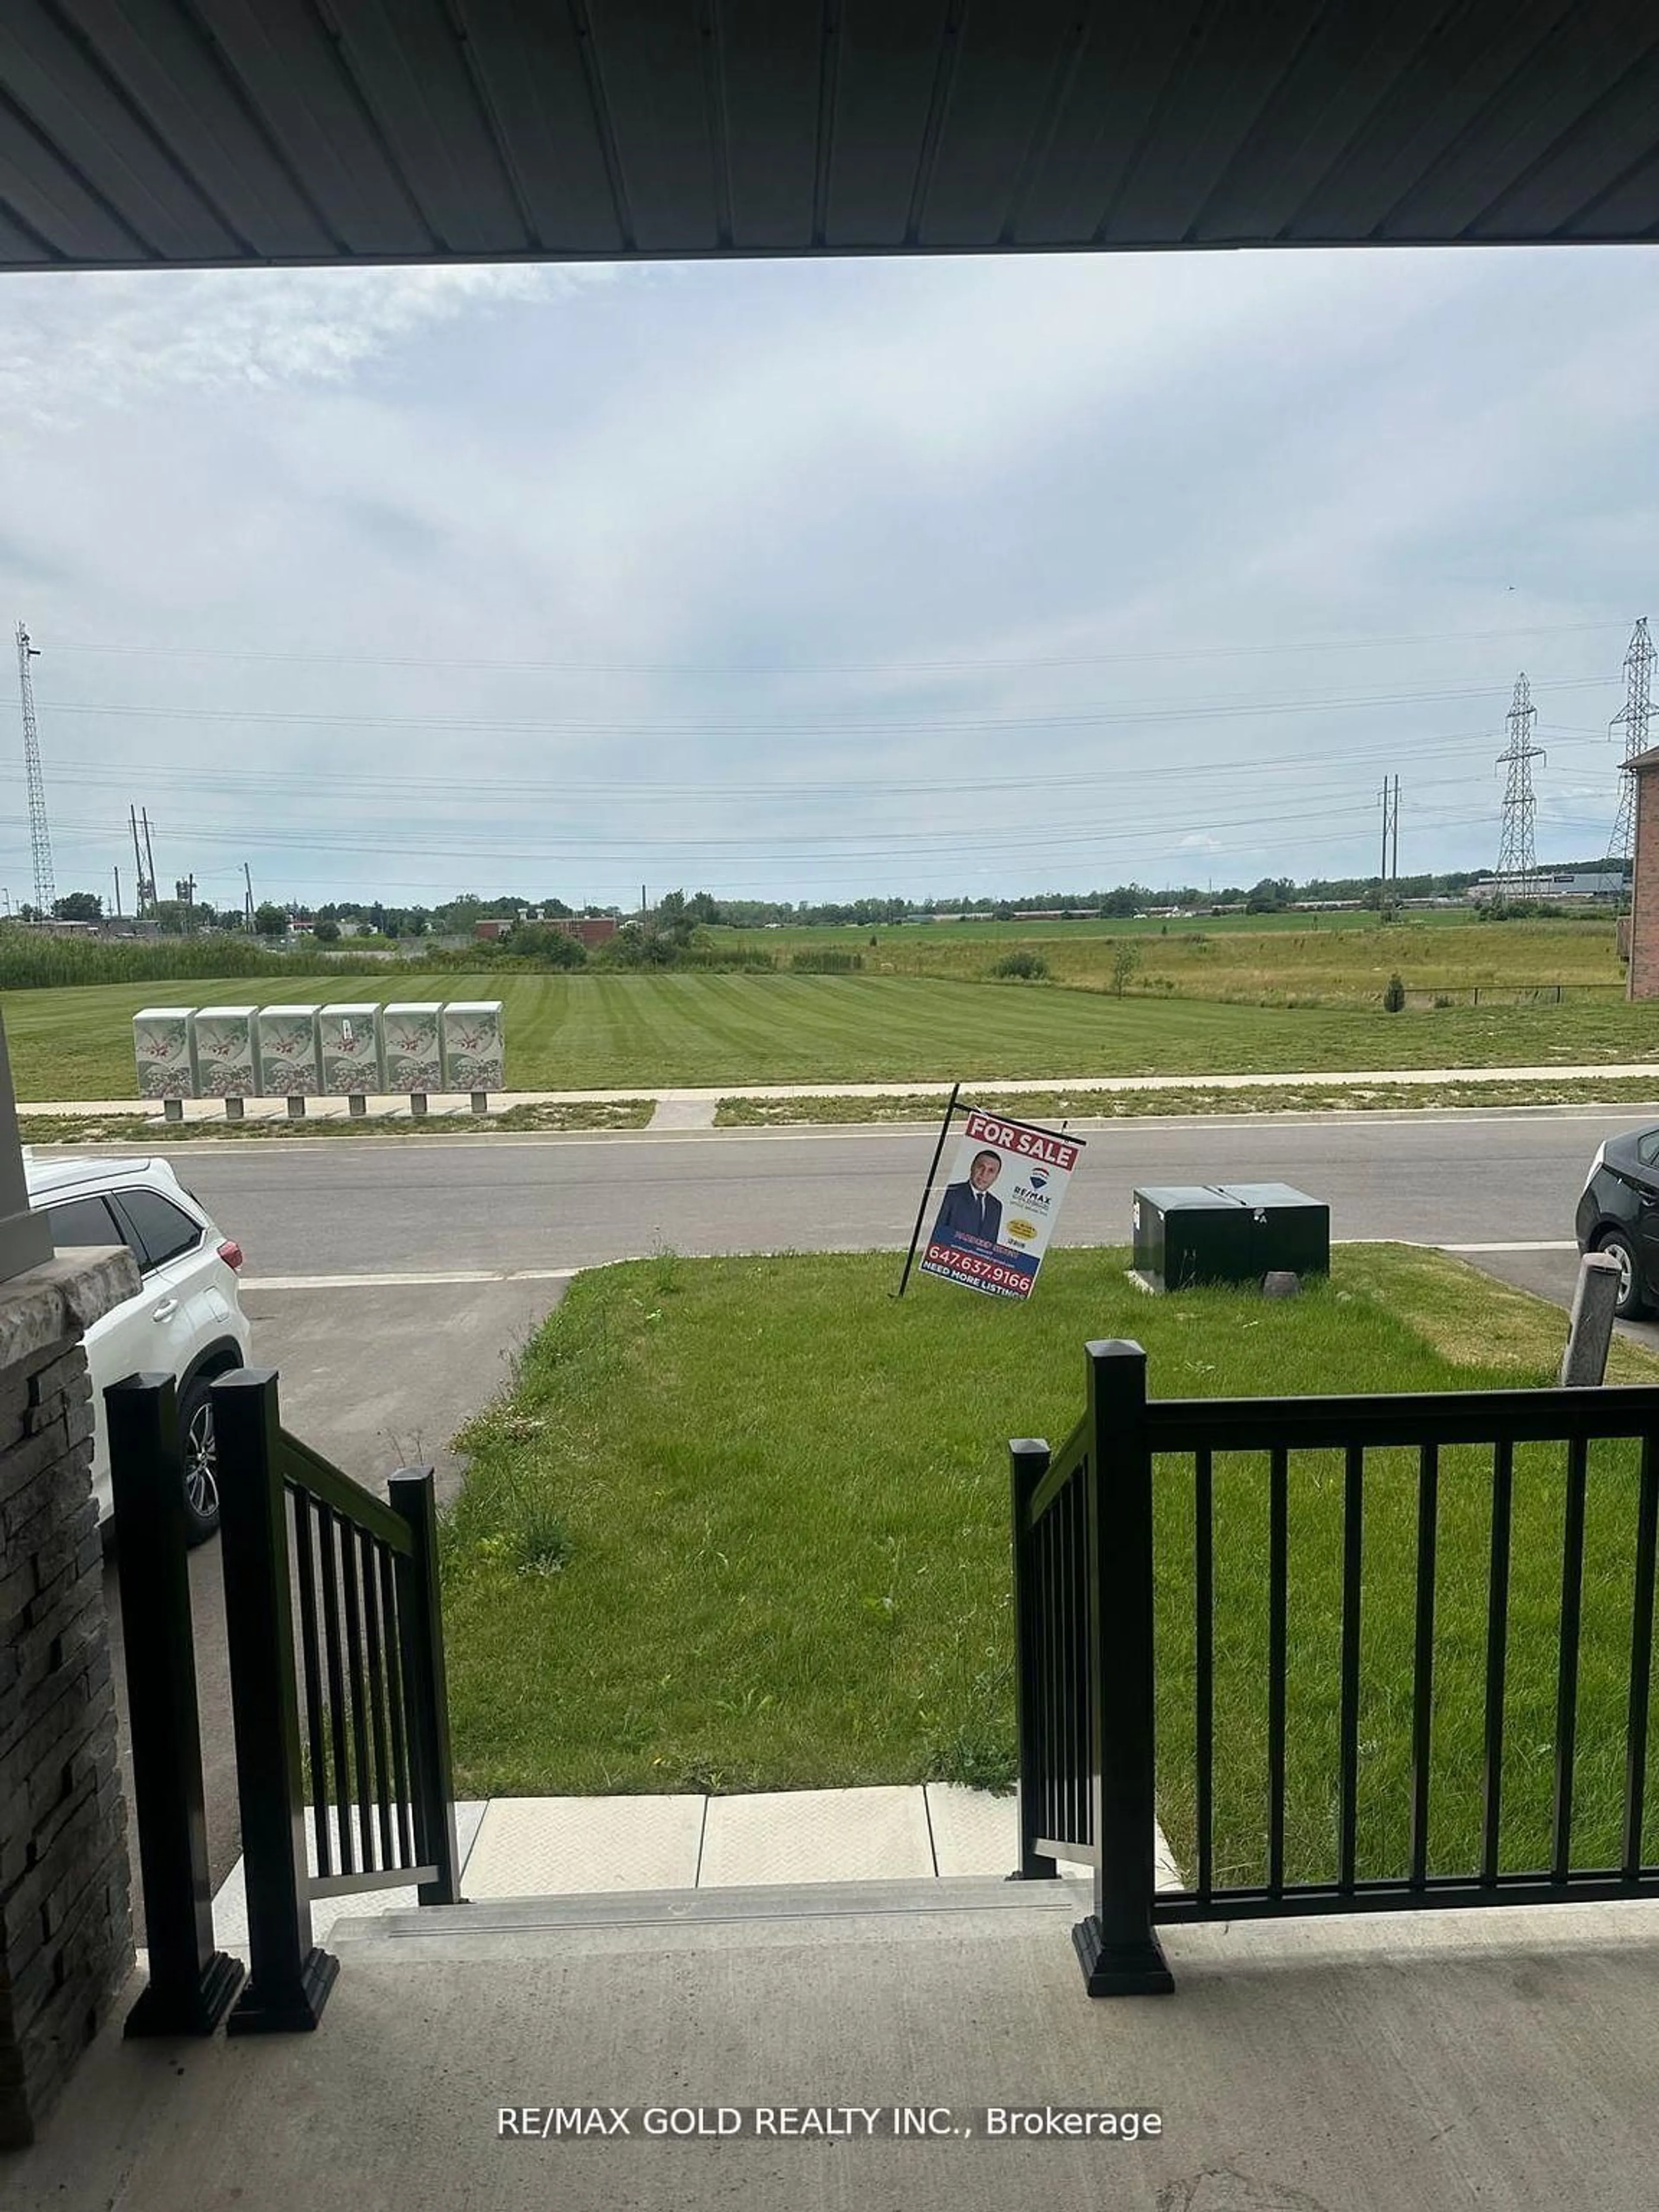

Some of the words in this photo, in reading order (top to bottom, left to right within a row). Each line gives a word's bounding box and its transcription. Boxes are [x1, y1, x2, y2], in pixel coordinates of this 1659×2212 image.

[970, 1117, 1015, 1147] FOR
[1017, 1134, 1072, 1166] SALE
[1014, 1186, 1052, 1205] RE/MAX
[923, 1260, 950, 1275] NEED
[951, 1270, 981, 1287] MORE
[929, 1246, 1030, 1291] 647.637.9166
